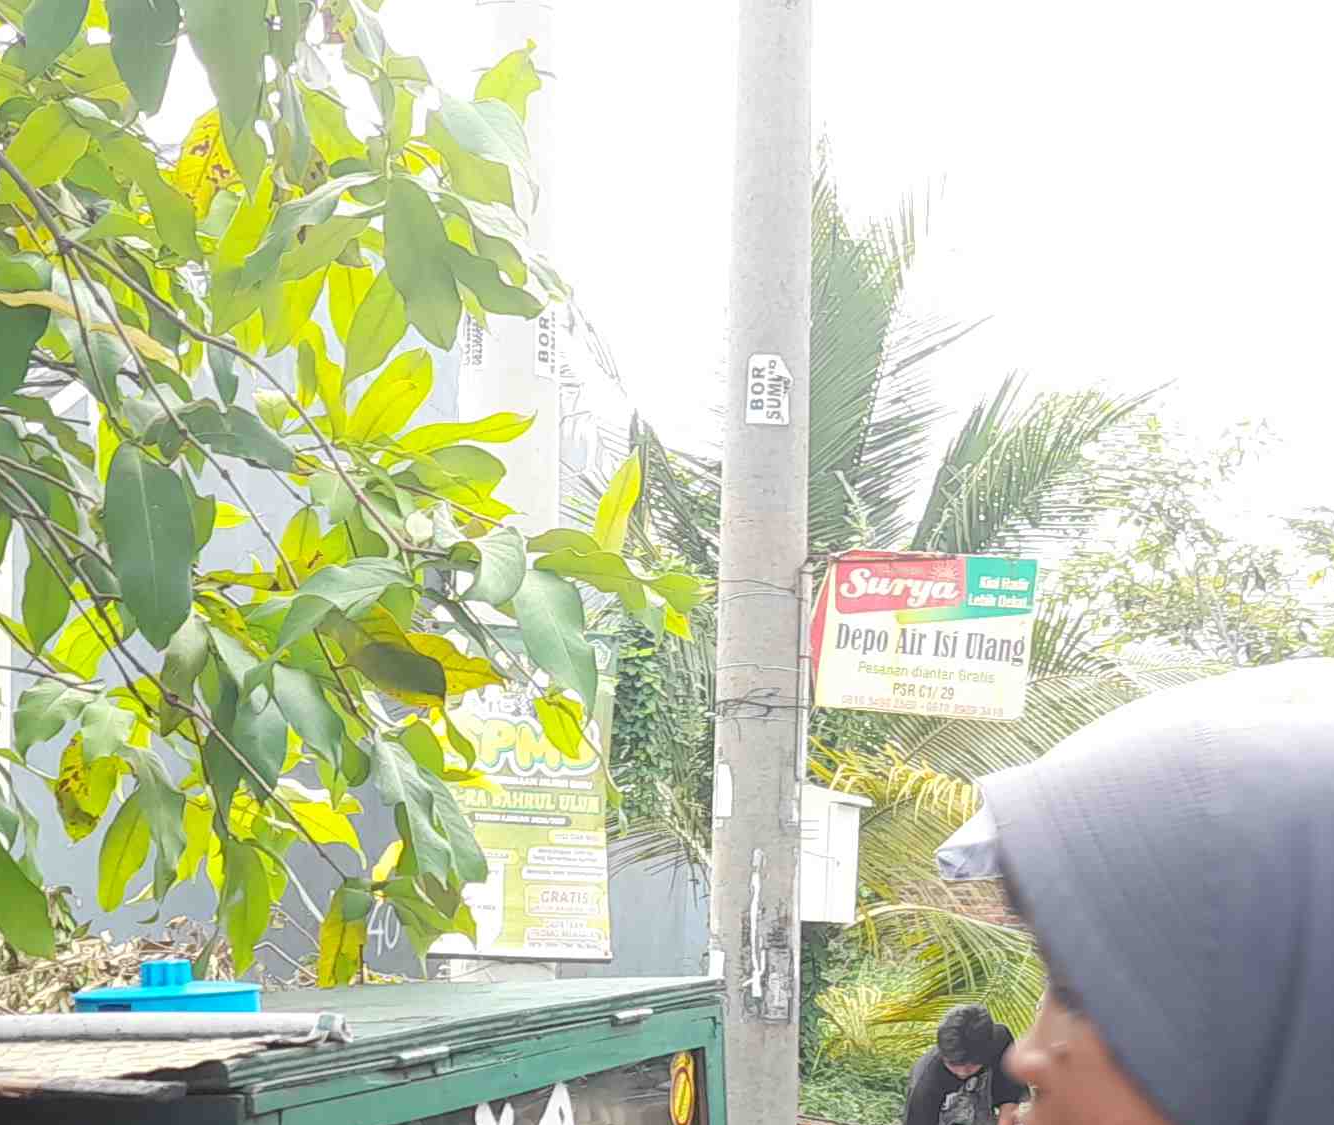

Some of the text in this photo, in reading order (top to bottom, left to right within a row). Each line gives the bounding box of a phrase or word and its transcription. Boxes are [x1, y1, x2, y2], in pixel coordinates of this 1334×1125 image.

[750, 366, 765, 411] BOR
[839, 567, 960, 608] Surya
[835, 623, 1025, 667] Depo Air Isi Ulang
[892, 682, 916, 697] PSR
[540, 889, 589, 905] GRATIS
